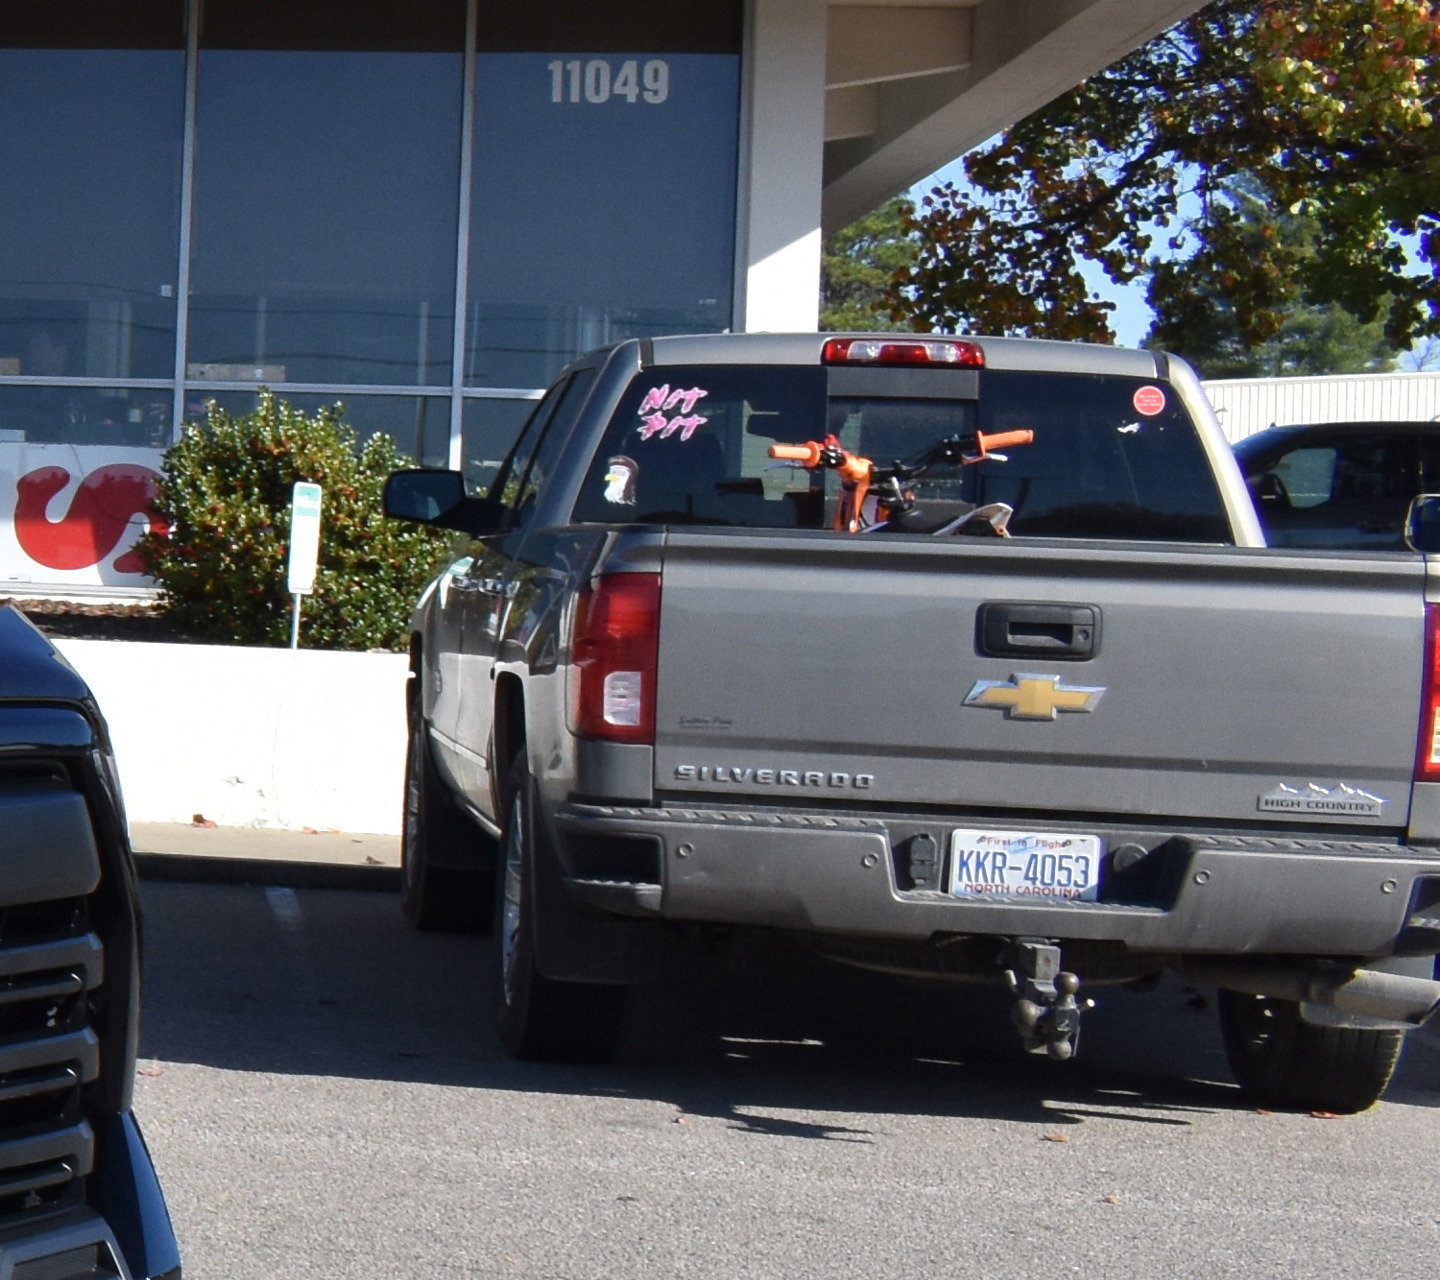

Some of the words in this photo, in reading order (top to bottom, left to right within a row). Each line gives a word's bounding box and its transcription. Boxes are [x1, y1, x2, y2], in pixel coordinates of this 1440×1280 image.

[547, 59, 669, 103] 11049
[675, 764, 875, 790] SILVERADO
[1263, 798, 1300, 809] HIGH
[1306, 800, 1375, 812] COUNTRY
[987, 836, 1011, 847] First
[958, 849, 1090, 889] KKR-4053
[964, 882, 1011, 896] NORTH
[1015, 885, 1081, 900] CAROLINA
